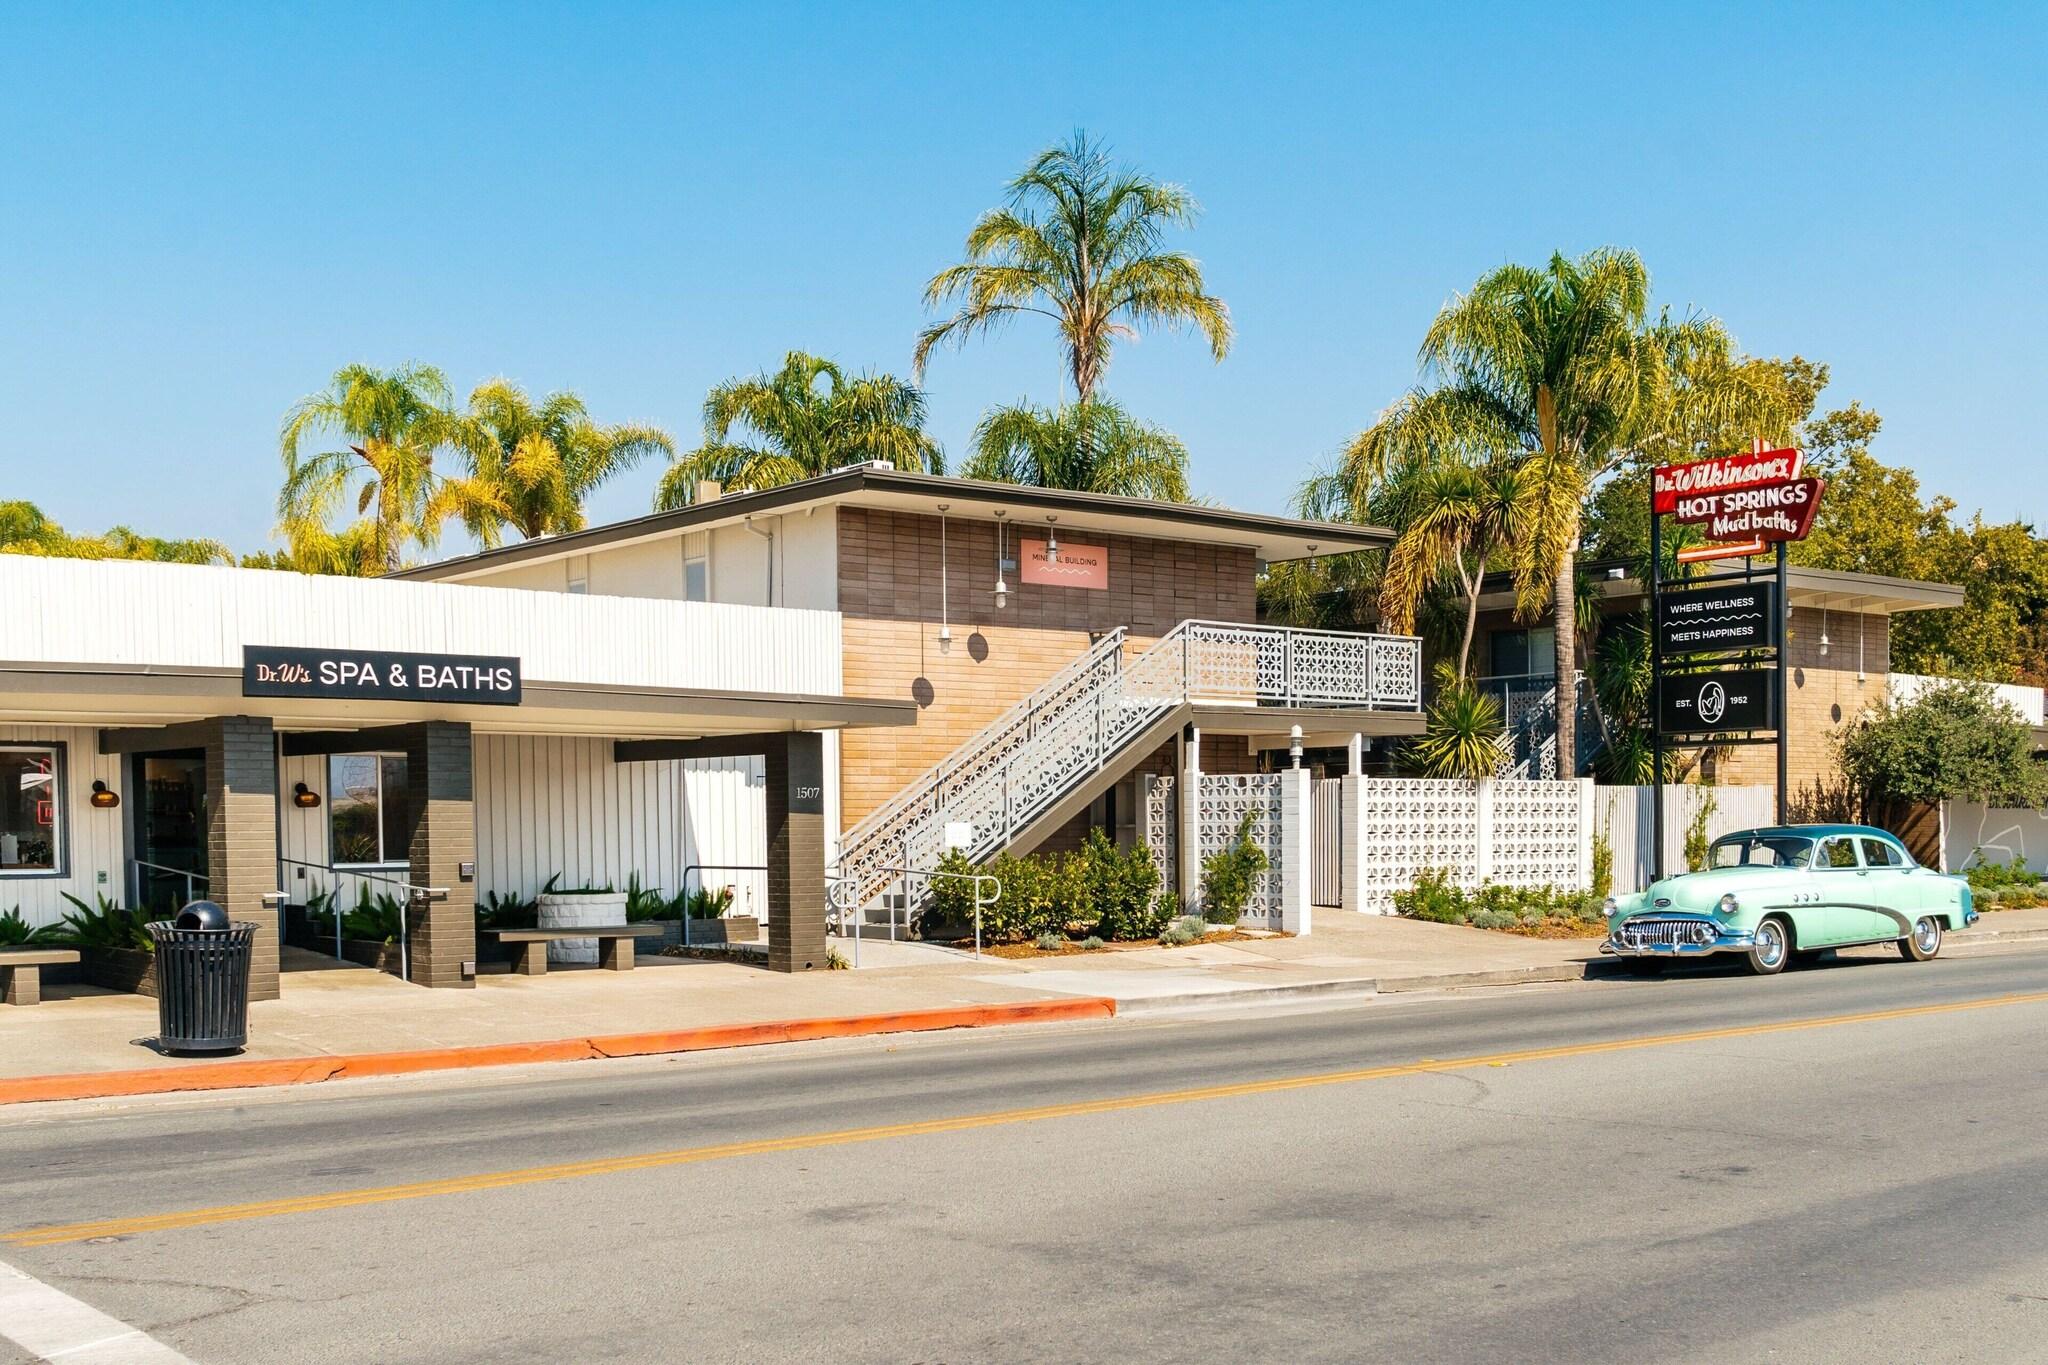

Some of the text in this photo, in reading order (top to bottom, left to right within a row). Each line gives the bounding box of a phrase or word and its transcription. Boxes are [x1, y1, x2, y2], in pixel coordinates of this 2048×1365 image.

[1677, 483, 1808, 519] HOT SPRINGS
[1032, 553, 1098, 567] MINEAL BUILDING
[1670, 597, 1755, 614] WHERE WELLNESS
[1671, 626, 1754, 642] MEETS HAPPINESS
[319, 660, 380, 687] SPA
[388, 662, 410, 688] &
[417, 664, 513, 691] BATHS
[1675, 695, 1748, 708] EST. 1952
[796, 787, 820, 799] 1507
